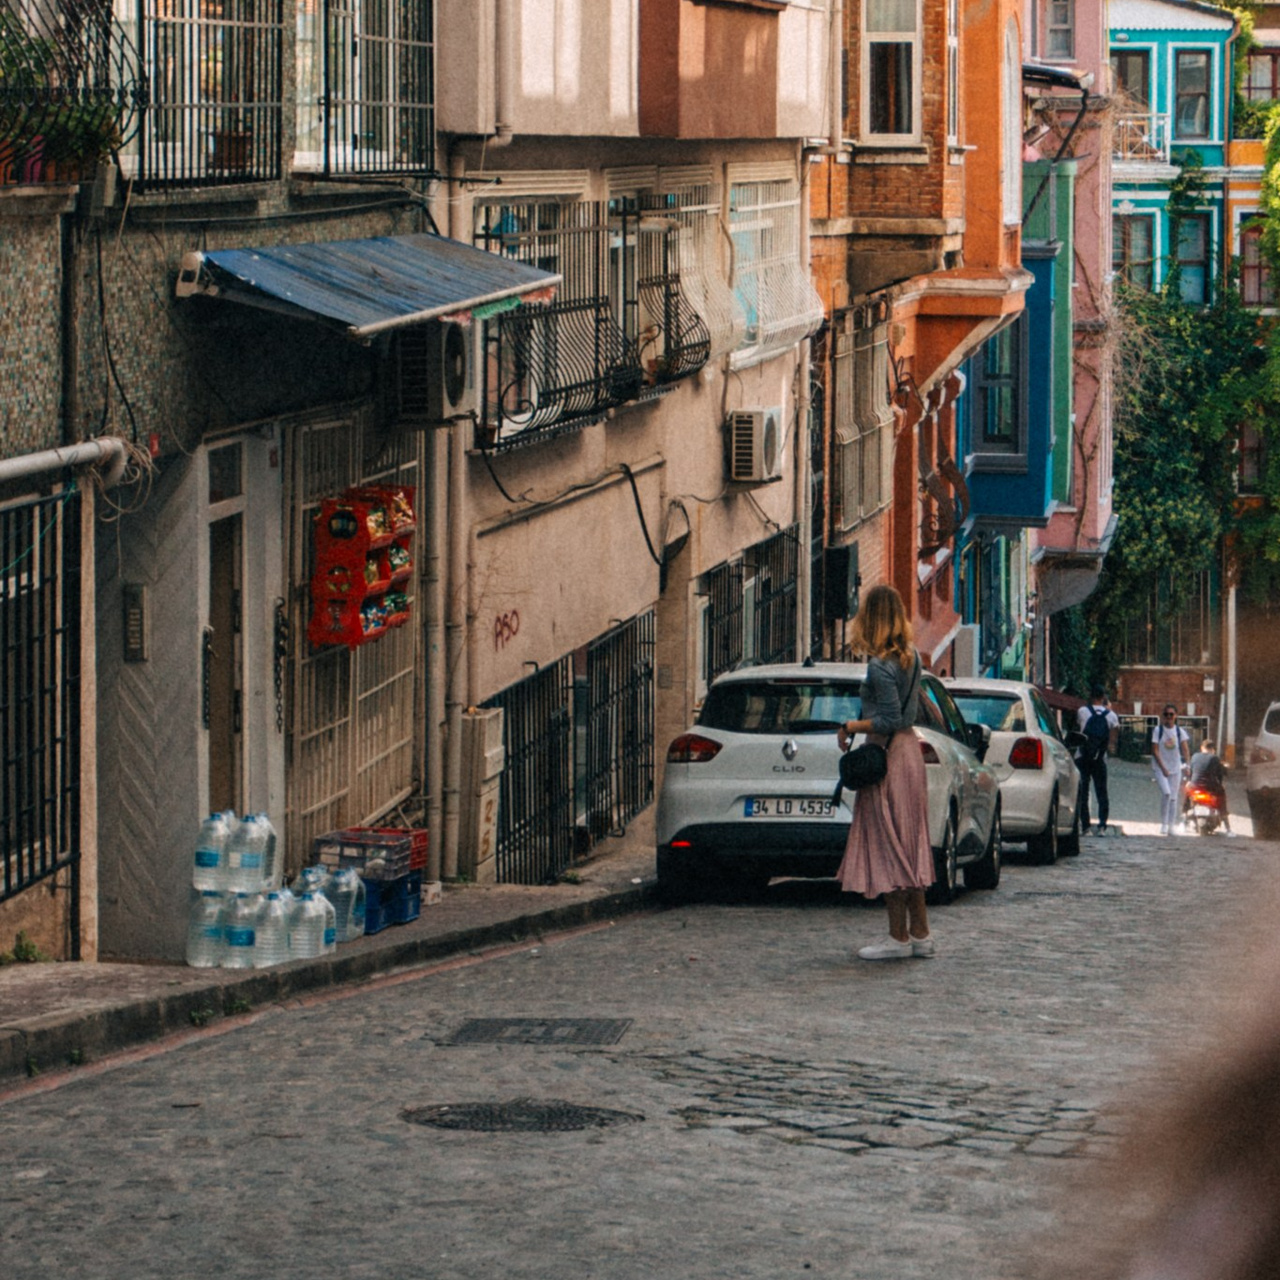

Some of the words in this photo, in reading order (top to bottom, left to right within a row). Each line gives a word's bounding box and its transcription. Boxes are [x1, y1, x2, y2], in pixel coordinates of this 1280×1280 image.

[772, 765, 805, 773] CLIO
[753, 800, 769, 815] 34
[776, 800, 793, 815] LD
[799, 800, 832, 815] 4539
